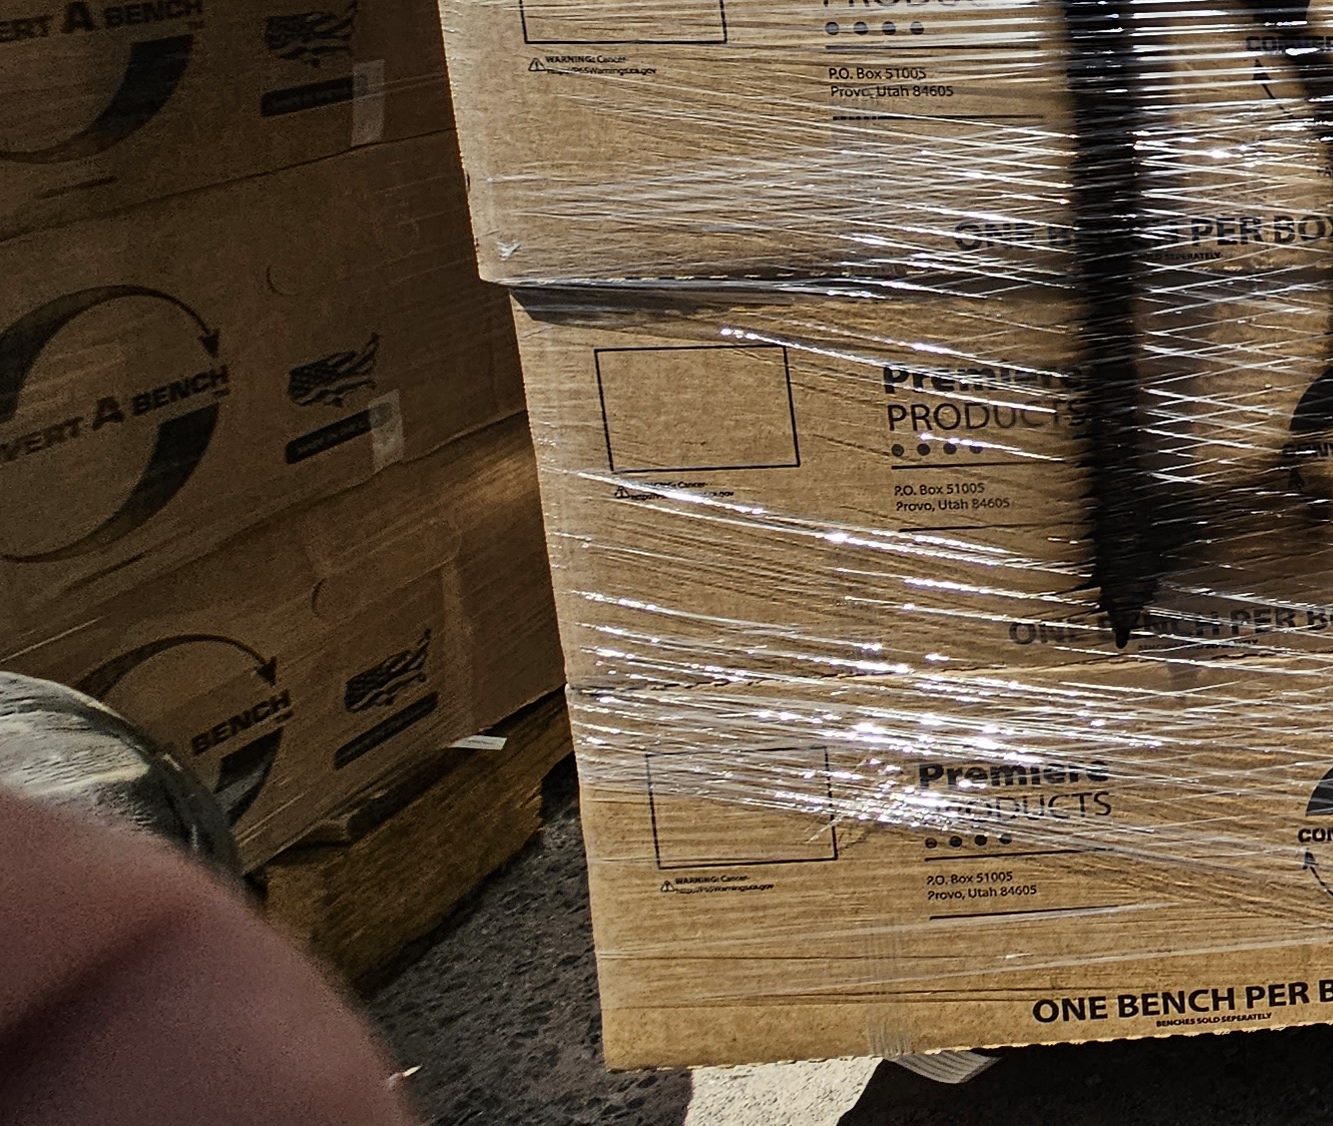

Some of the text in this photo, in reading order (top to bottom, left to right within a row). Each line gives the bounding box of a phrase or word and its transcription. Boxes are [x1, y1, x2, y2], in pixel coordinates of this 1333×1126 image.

[61, 1, 94, 34] A
[1192, 218, 1265, 245] PER
[92, 397, 124, 432] A
[131, 366, 229, 416] BENCH
[193, 690, 292, 755] BENCH
[1033, 995, 1107, 1023] ONE
[1117, 987, 1236, 1019] BENCH
[1246, 982, 1308, 1010] PER
[1157, 1012, 1272, 1028] BENCHES SOLD SEPERATELY
